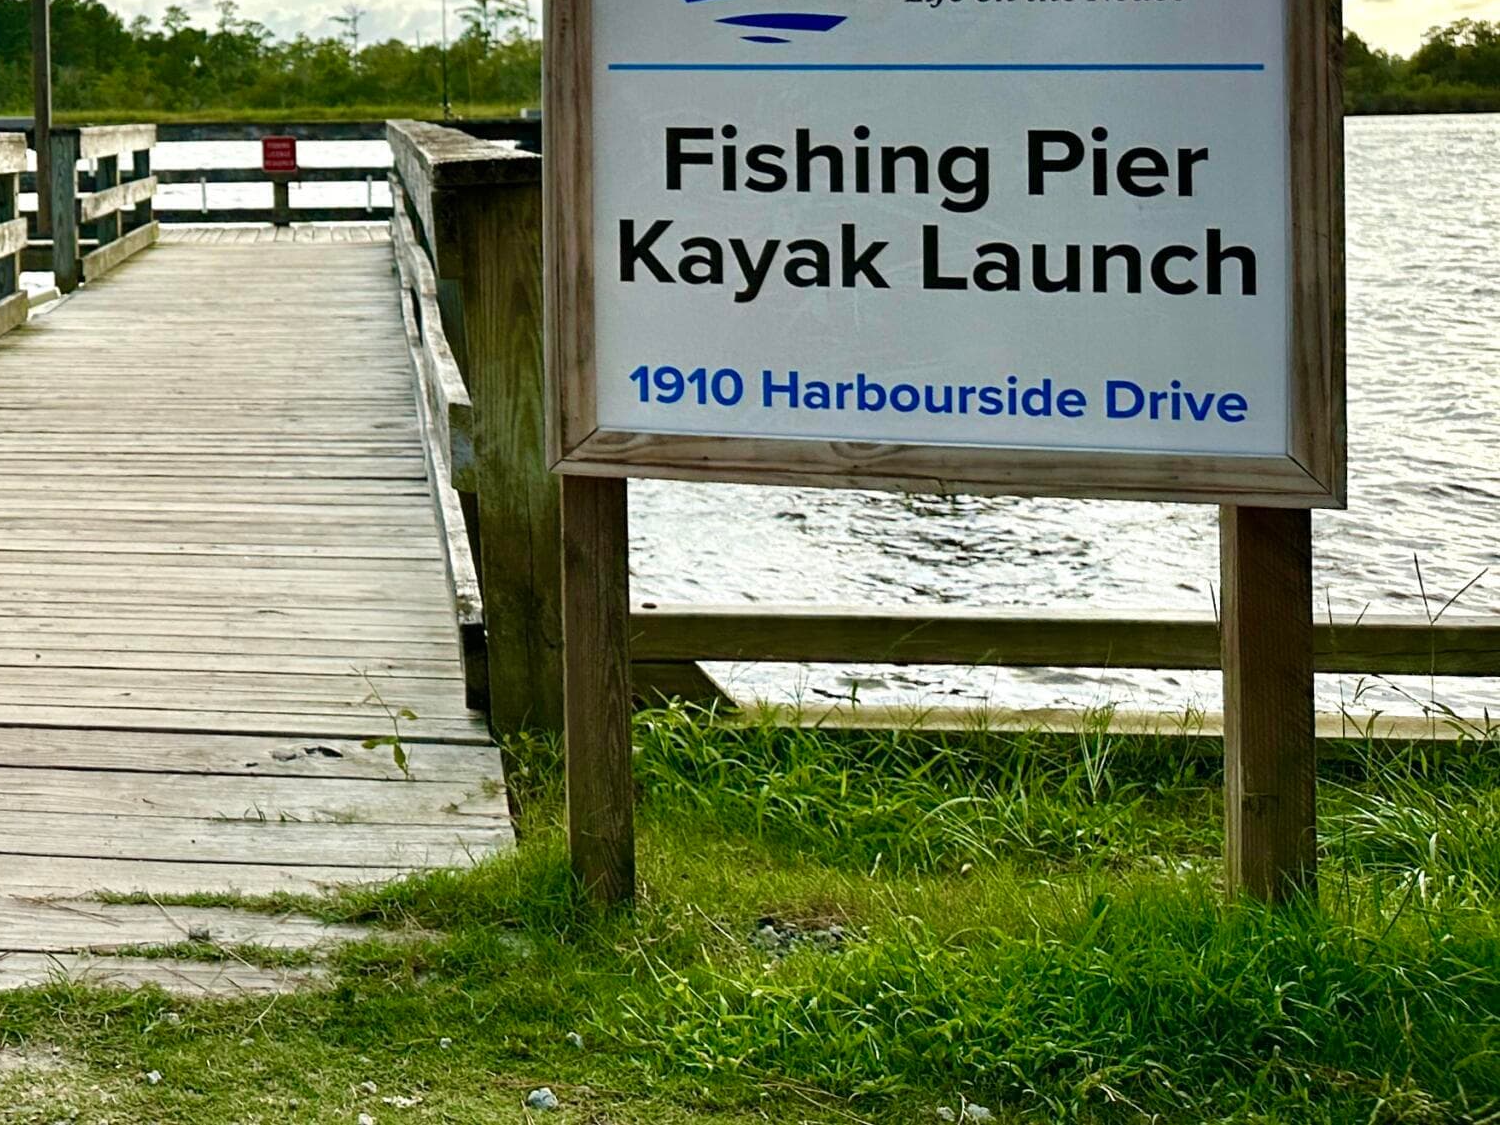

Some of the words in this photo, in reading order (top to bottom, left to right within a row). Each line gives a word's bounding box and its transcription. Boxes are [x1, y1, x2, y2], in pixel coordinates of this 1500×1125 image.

[665, 124, 990, 214] Fishing
[1027, 126, 1209, 198] Pier
[619, 218, 891, 304] Kayak
[922, 224, 1257, 296] Launch
[629, 365, 744, 407] 1910
[762, 369, 1088, 418] Harbourside
[1106, 379, 1249, 423] Drive
